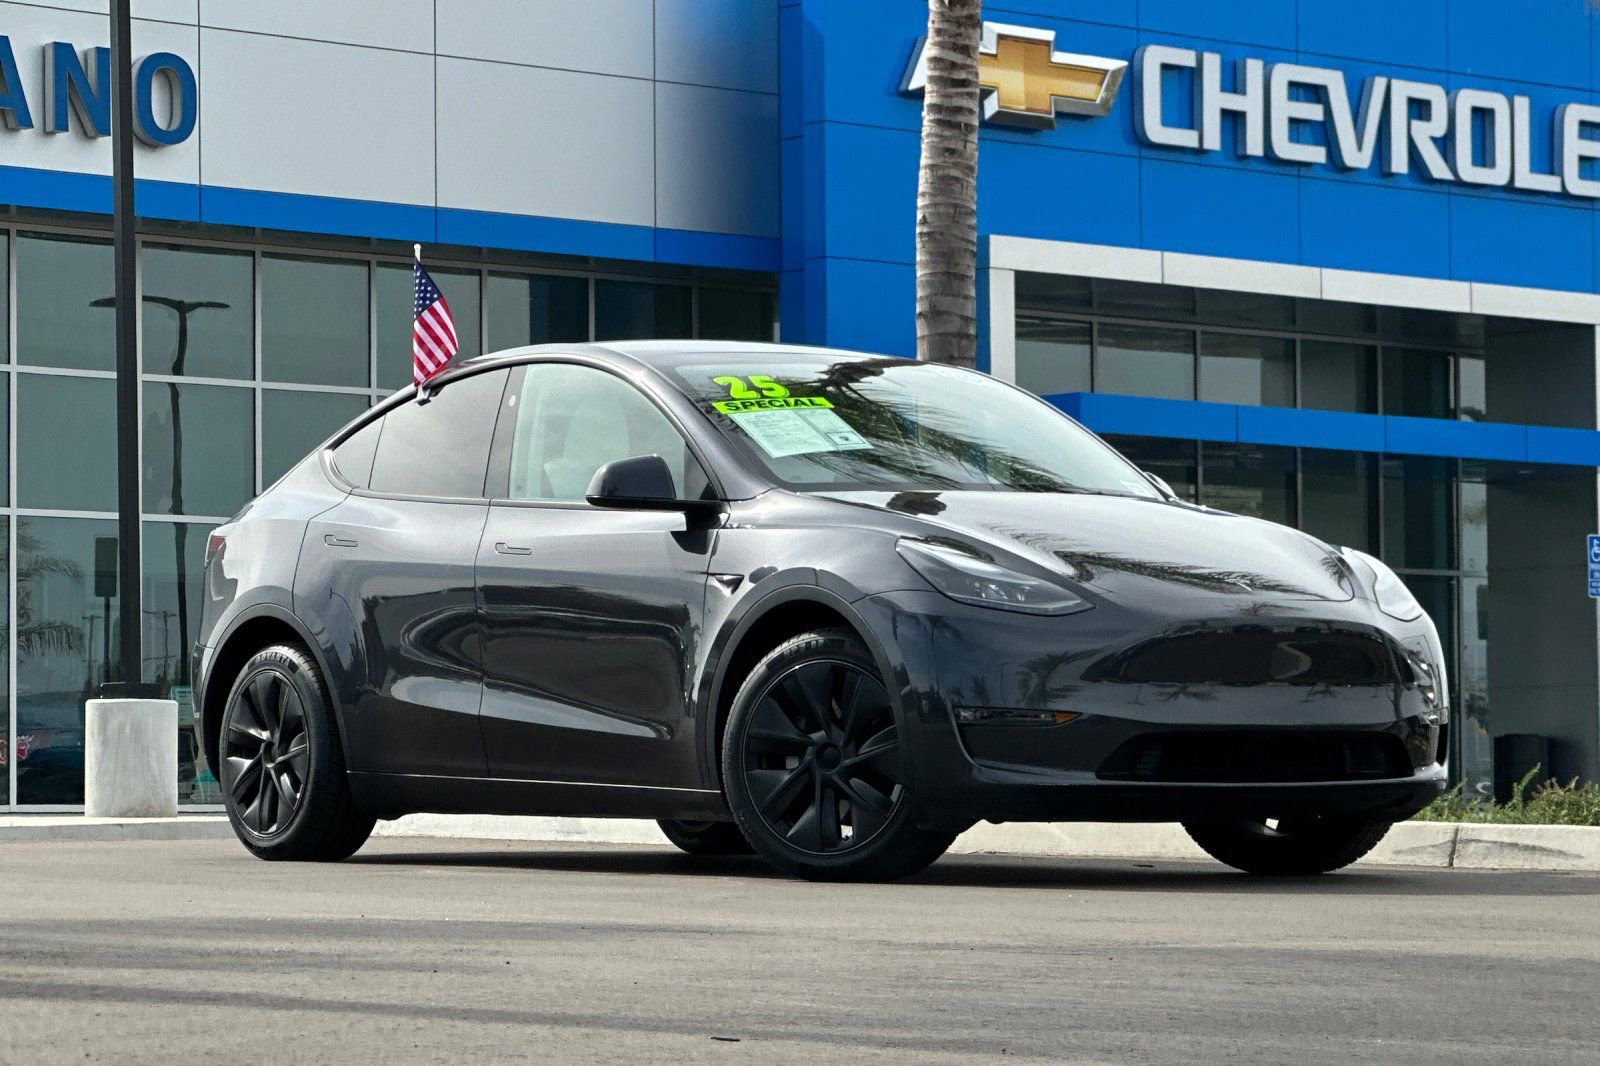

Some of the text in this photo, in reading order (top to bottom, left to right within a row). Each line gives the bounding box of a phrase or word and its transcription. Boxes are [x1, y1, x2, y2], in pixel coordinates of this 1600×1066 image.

[1135, 44, 1600, 198] CHEVROLE
[712, 375, 790, 400] 25
[724, 399, 823, 411] SPECIAL
